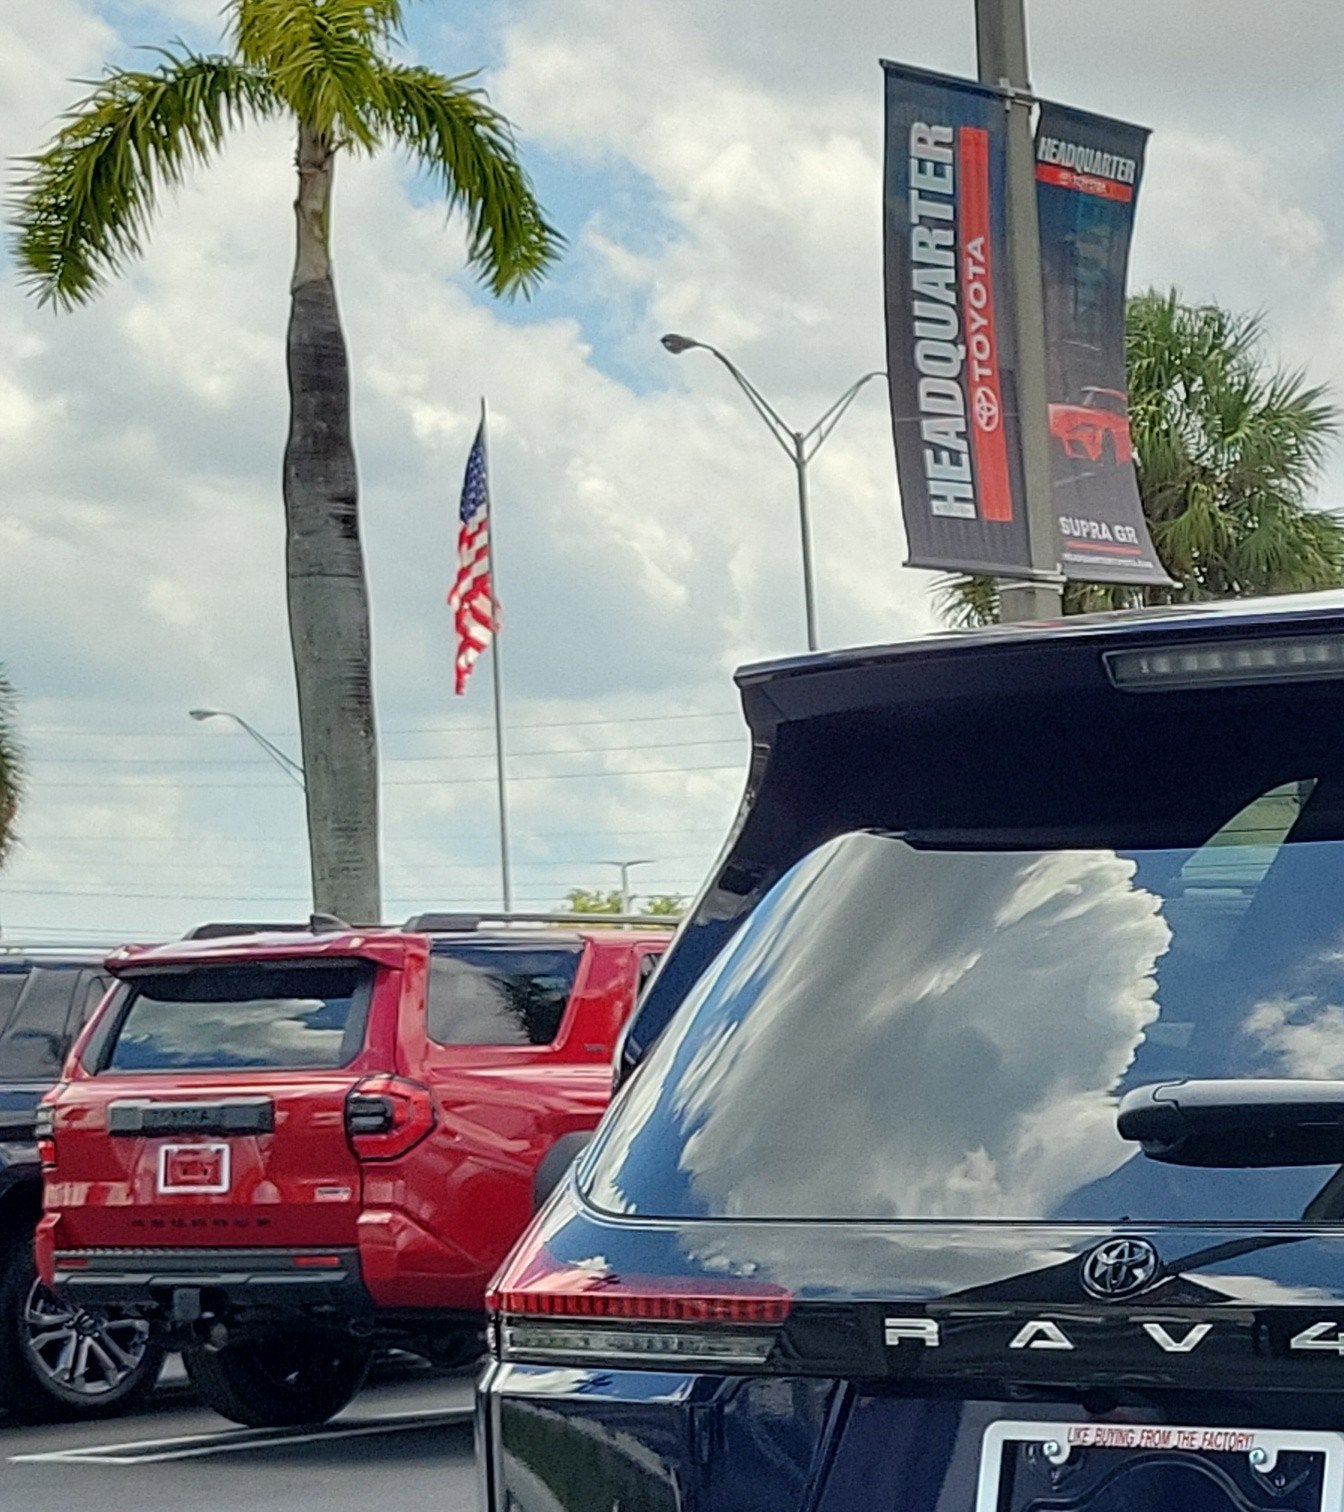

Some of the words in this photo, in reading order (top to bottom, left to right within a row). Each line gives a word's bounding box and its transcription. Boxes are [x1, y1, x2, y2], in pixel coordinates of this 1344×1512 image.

[1037, 136, 1136, 184] HEADQUARTER
[909, 121, 979, 520] HEADQUARTER
[967, 236, 993, 382] TOYOTA
[1059, 516, 1114, 542] SUPRA
[1113, 525, 1139, 545] GR
[1139, 1429, 1172, 1447] FROM
[1176, 1430, 1199, 1449] THE
